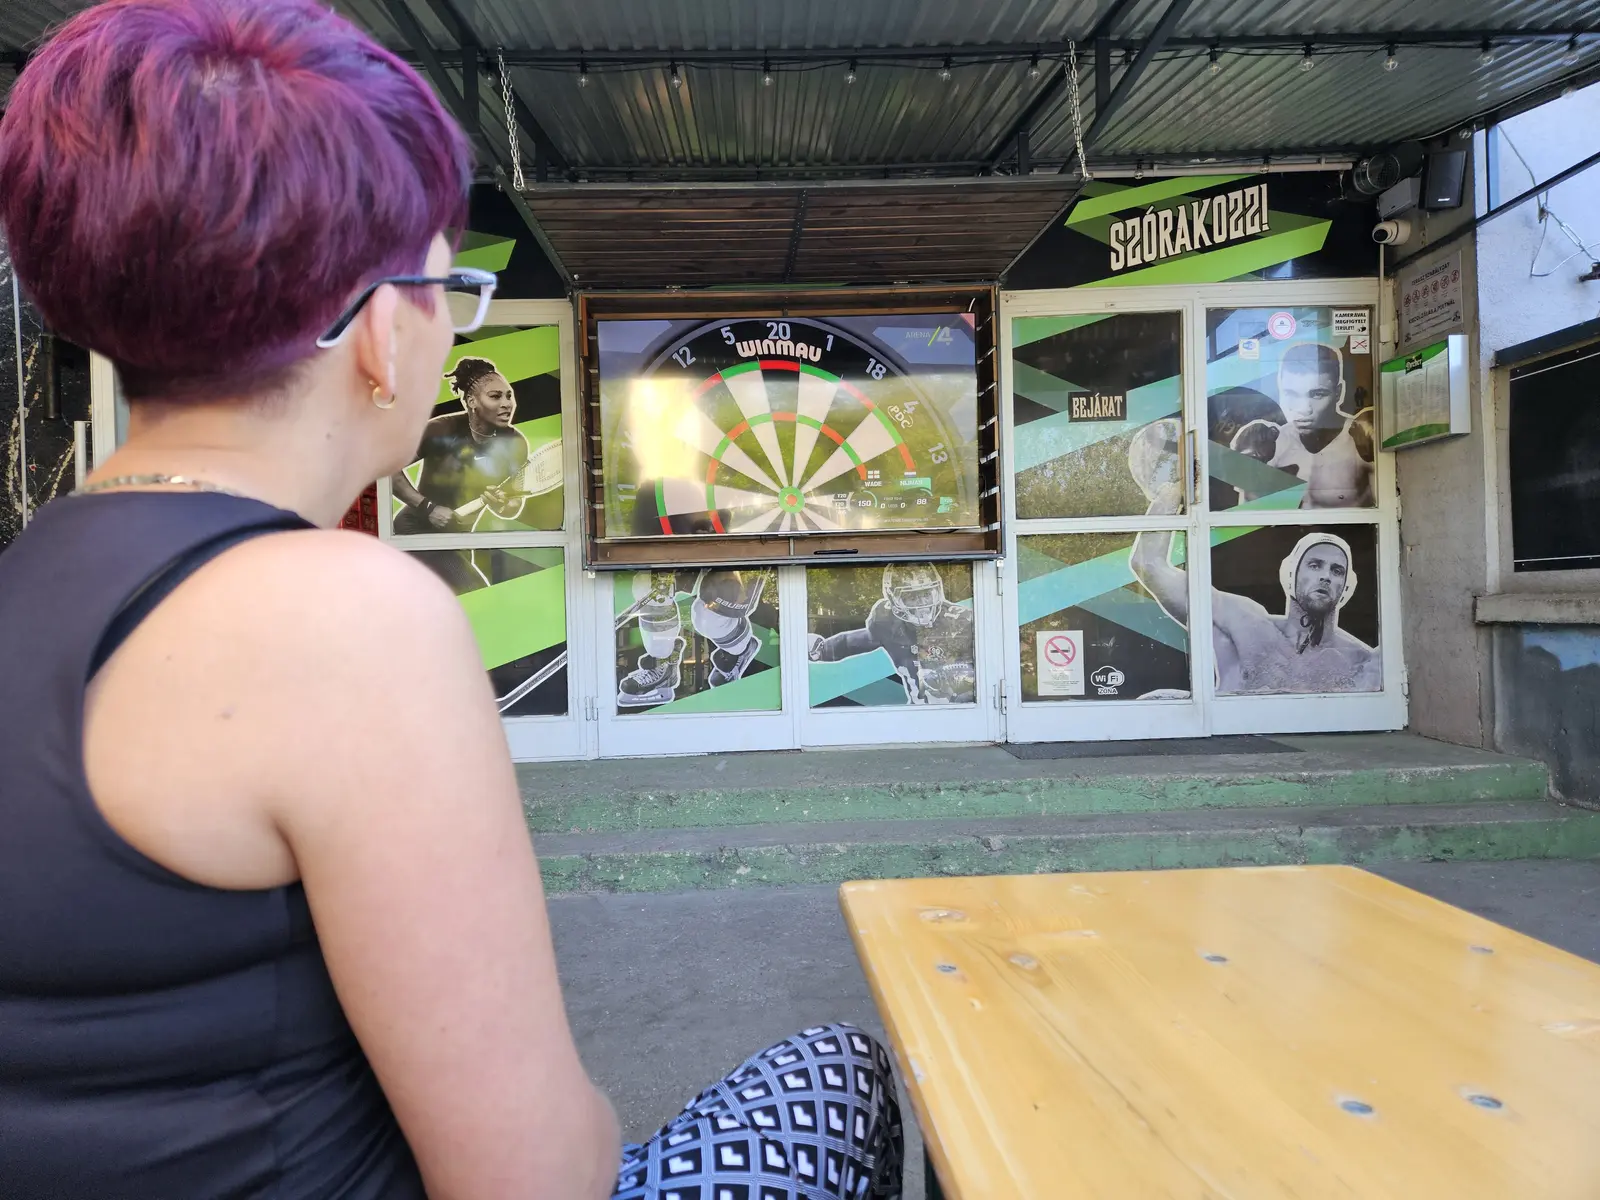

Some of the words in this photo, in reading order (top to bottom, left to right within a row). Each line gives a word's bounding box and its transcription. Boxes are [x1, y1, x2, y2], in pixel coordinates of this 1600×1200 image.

[1110, 183, 1270, 271] SZÓRAKOZZ!
[720, 326, 736, 345] 5
[766, 322, 791, 340] 20
[735, 338, 822, 362] WINMAU
[826, 334, 834, 352] 1
[672, 346, 696, 369] 12
[865, 357, 887, 380] 18
[1072, 392, 1123, 419] BEJÁRAT
[928, 443, 948, 464] 13
